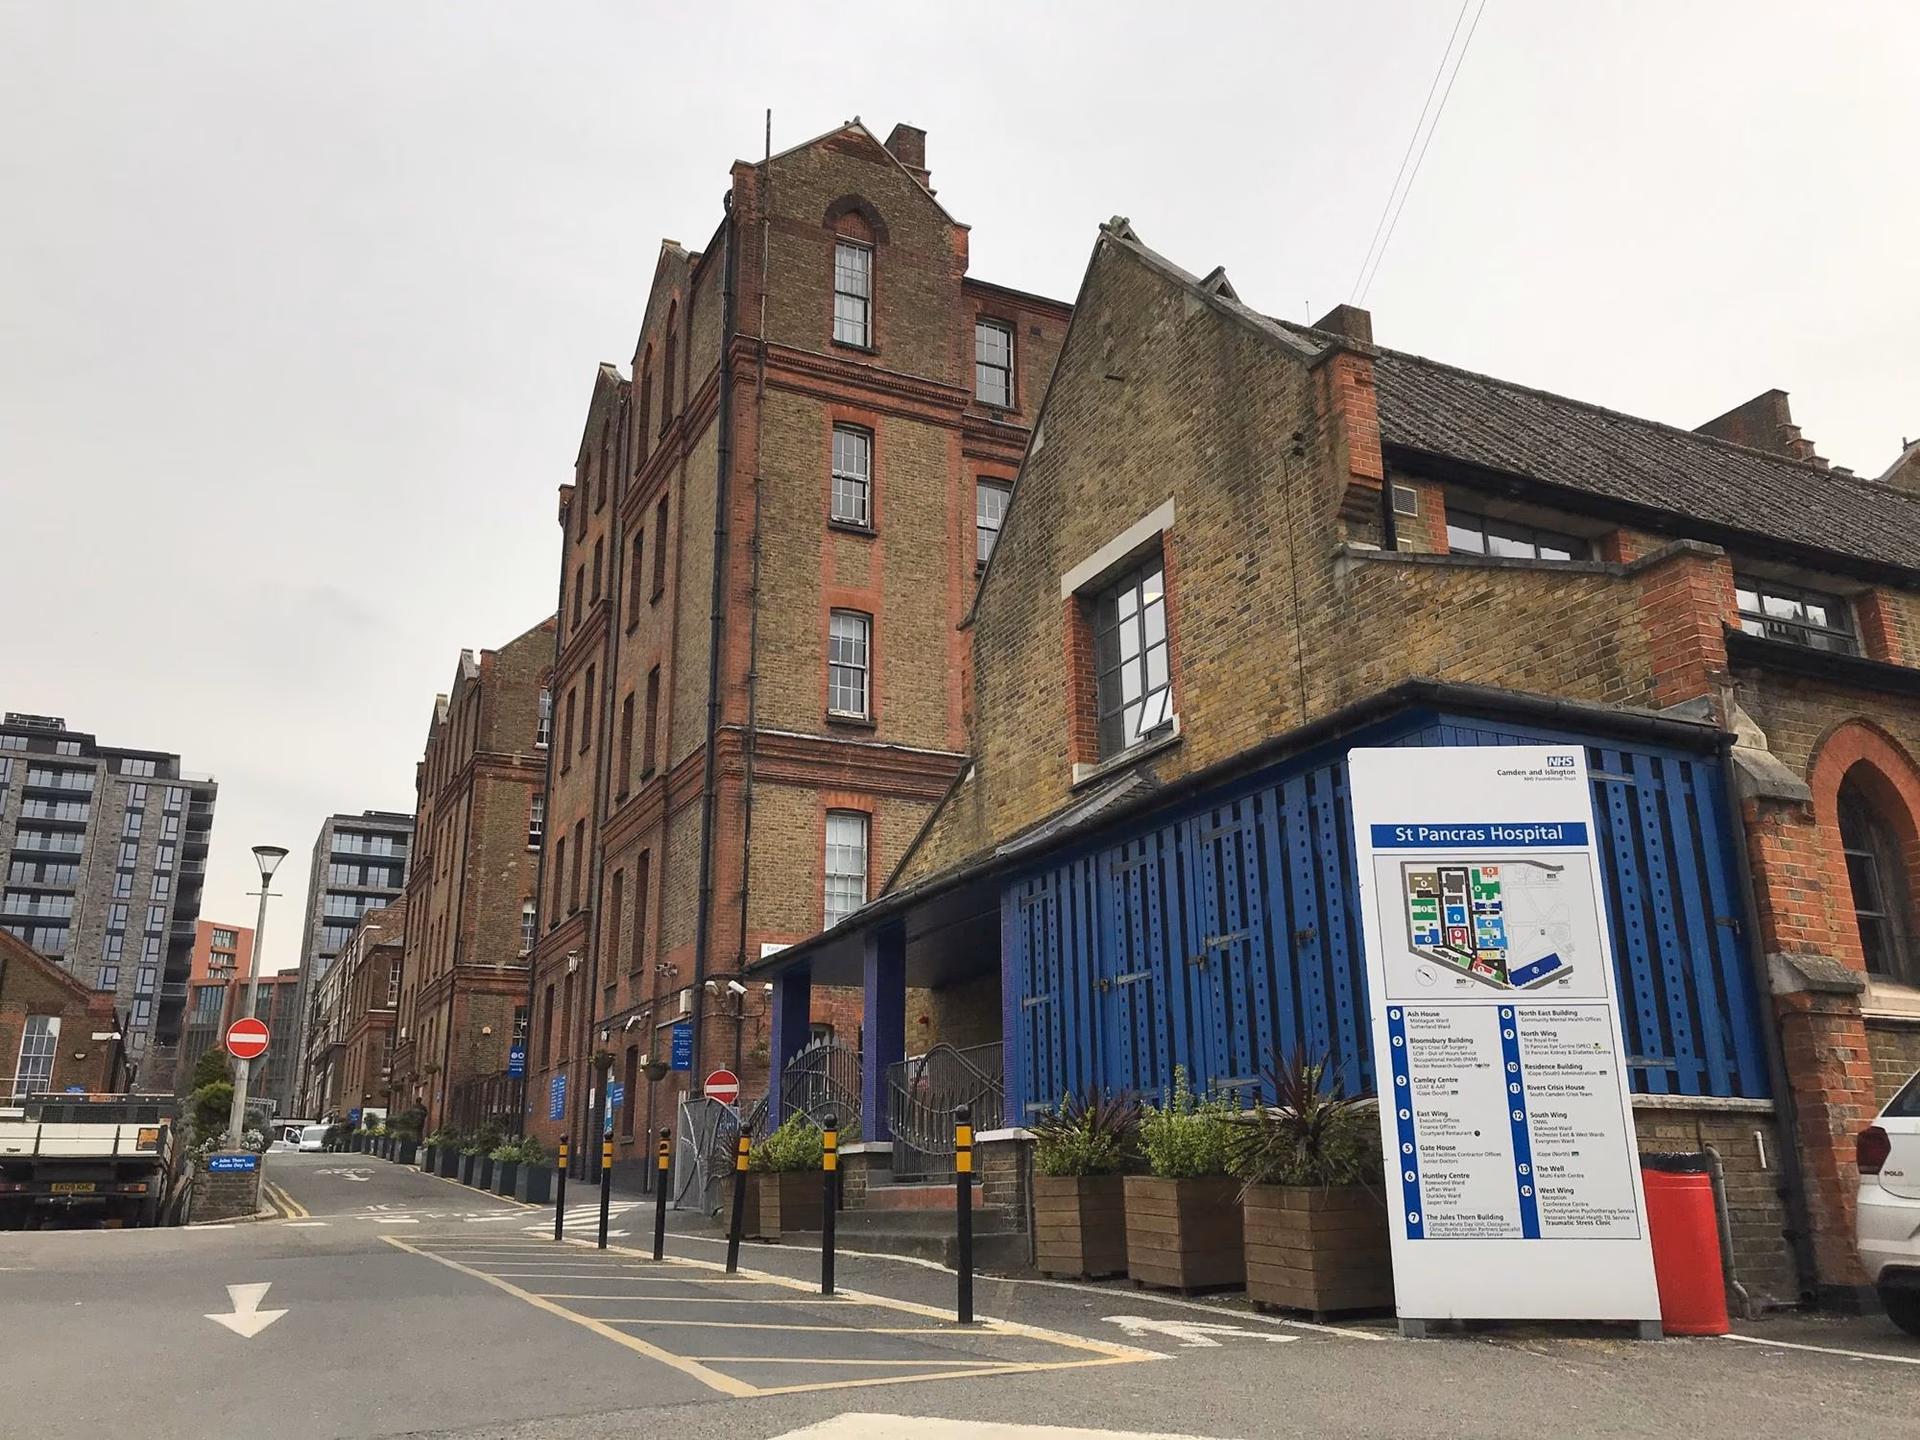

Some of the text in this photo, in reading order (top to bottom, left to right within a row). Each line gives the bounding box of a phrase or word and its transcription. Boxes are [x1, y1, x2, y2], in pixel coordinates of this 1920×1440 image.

[1548, 757, 1573, 767] NHS
[1396, 824, 1562, 843] St Pancras Hospital
